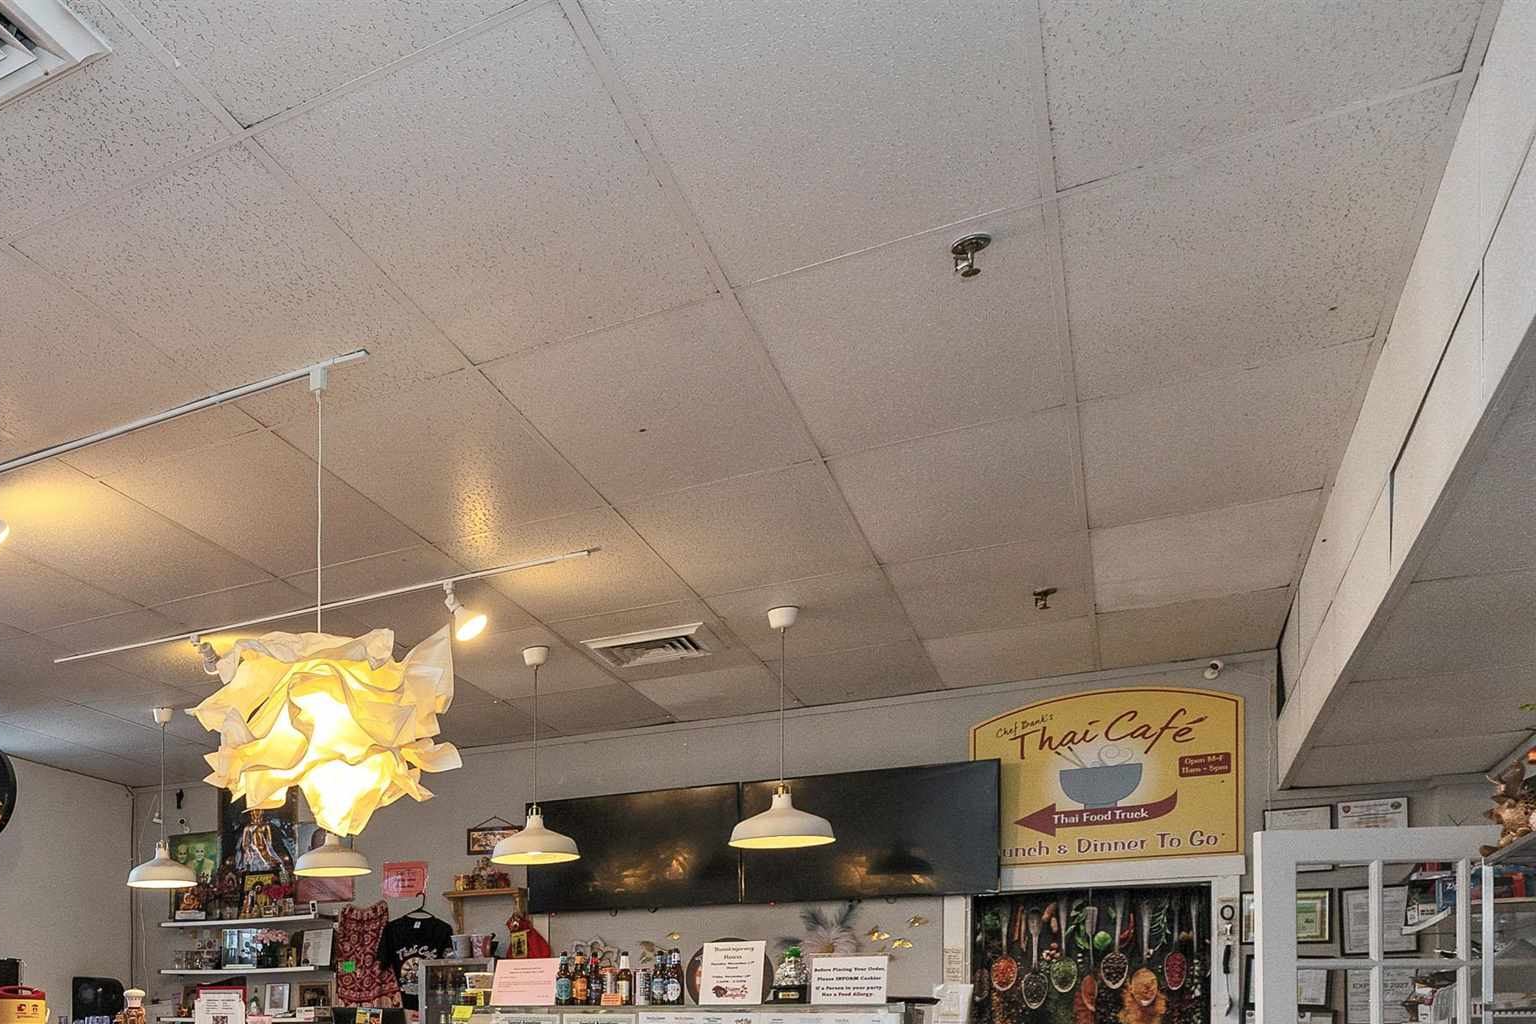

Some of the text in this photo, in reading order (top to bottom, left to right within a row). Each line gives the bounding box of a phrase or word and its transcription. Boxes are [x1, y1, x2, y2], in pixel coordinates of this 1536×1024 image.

[996, 722, 1018, 738] Chef
[1008, 708, 1209, 760] Thai Café
[1052, 808, 1150, 825] Thai Food Truck
[1000, 829, 1219, 858] unch & Dinner To Go
